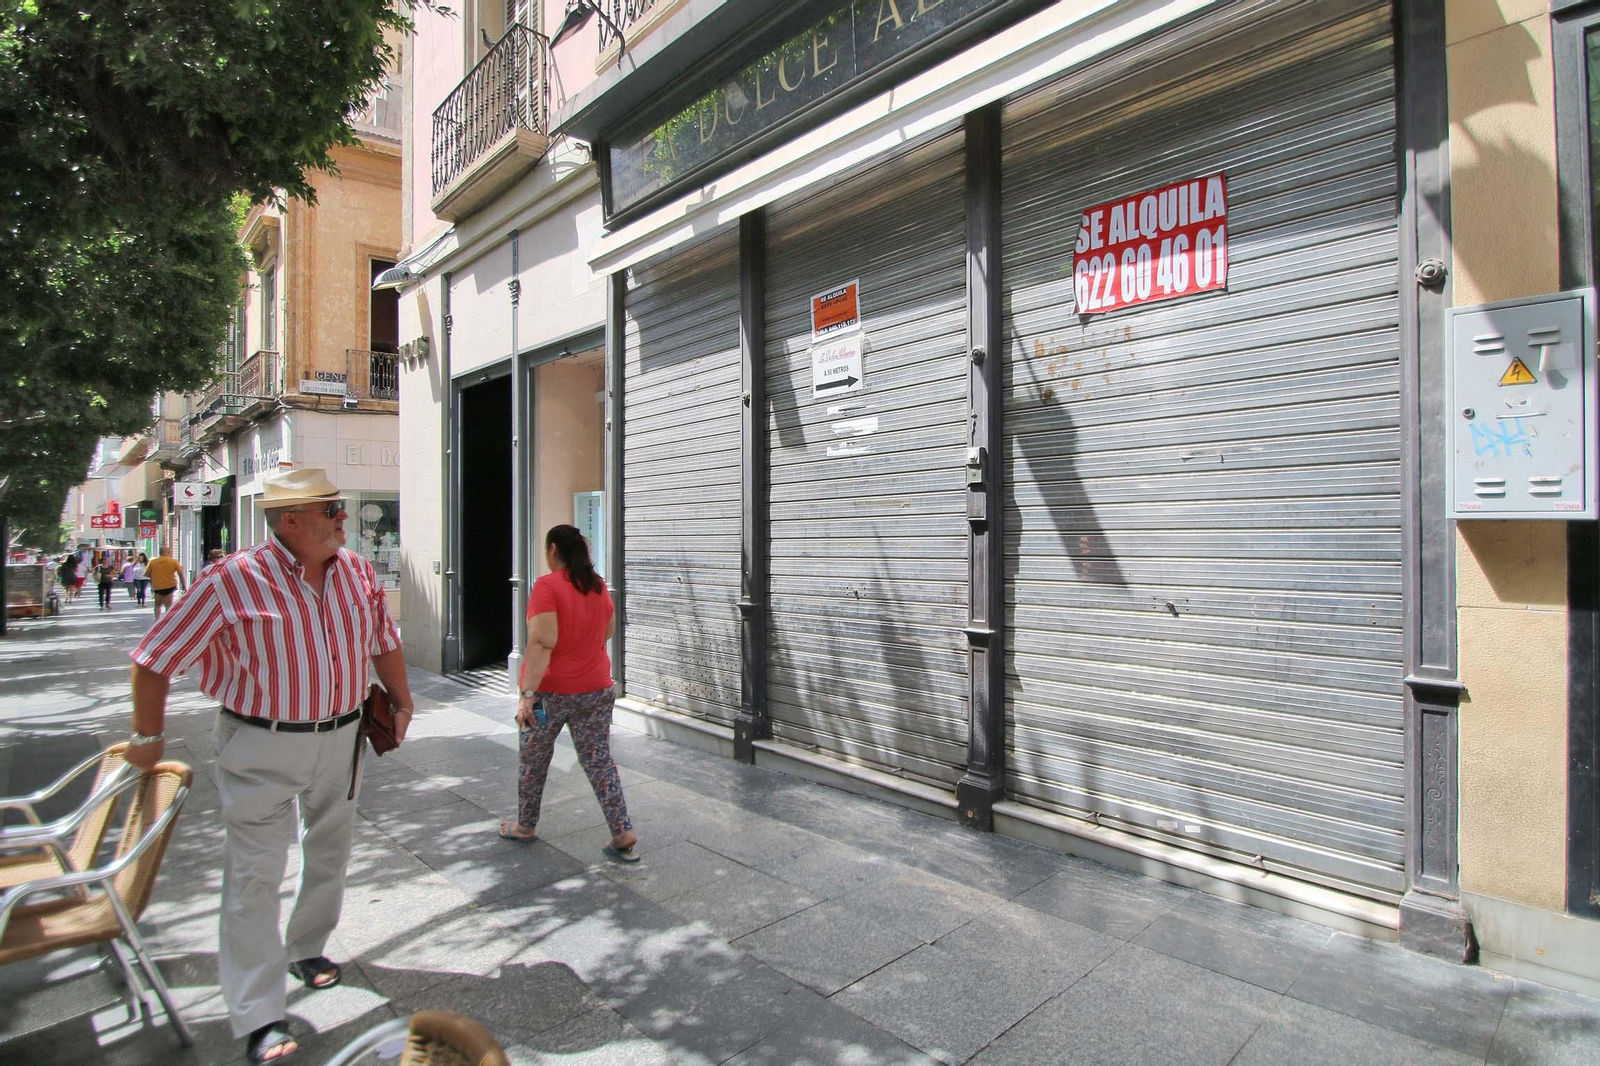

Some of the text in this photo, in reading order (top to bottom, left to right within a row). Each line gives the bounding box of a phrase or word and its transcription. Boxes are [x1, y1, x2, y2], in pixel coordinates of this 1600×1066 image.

[699, 28, 839, 144] DULCE
[1075, 175, 1226, 254] SE ALQUILA
[827, 288, 847, 301] ALQUILA
[1075, 224, 1226, 313] 622 60 46 01
[833, 364, 849, 375] METROS
